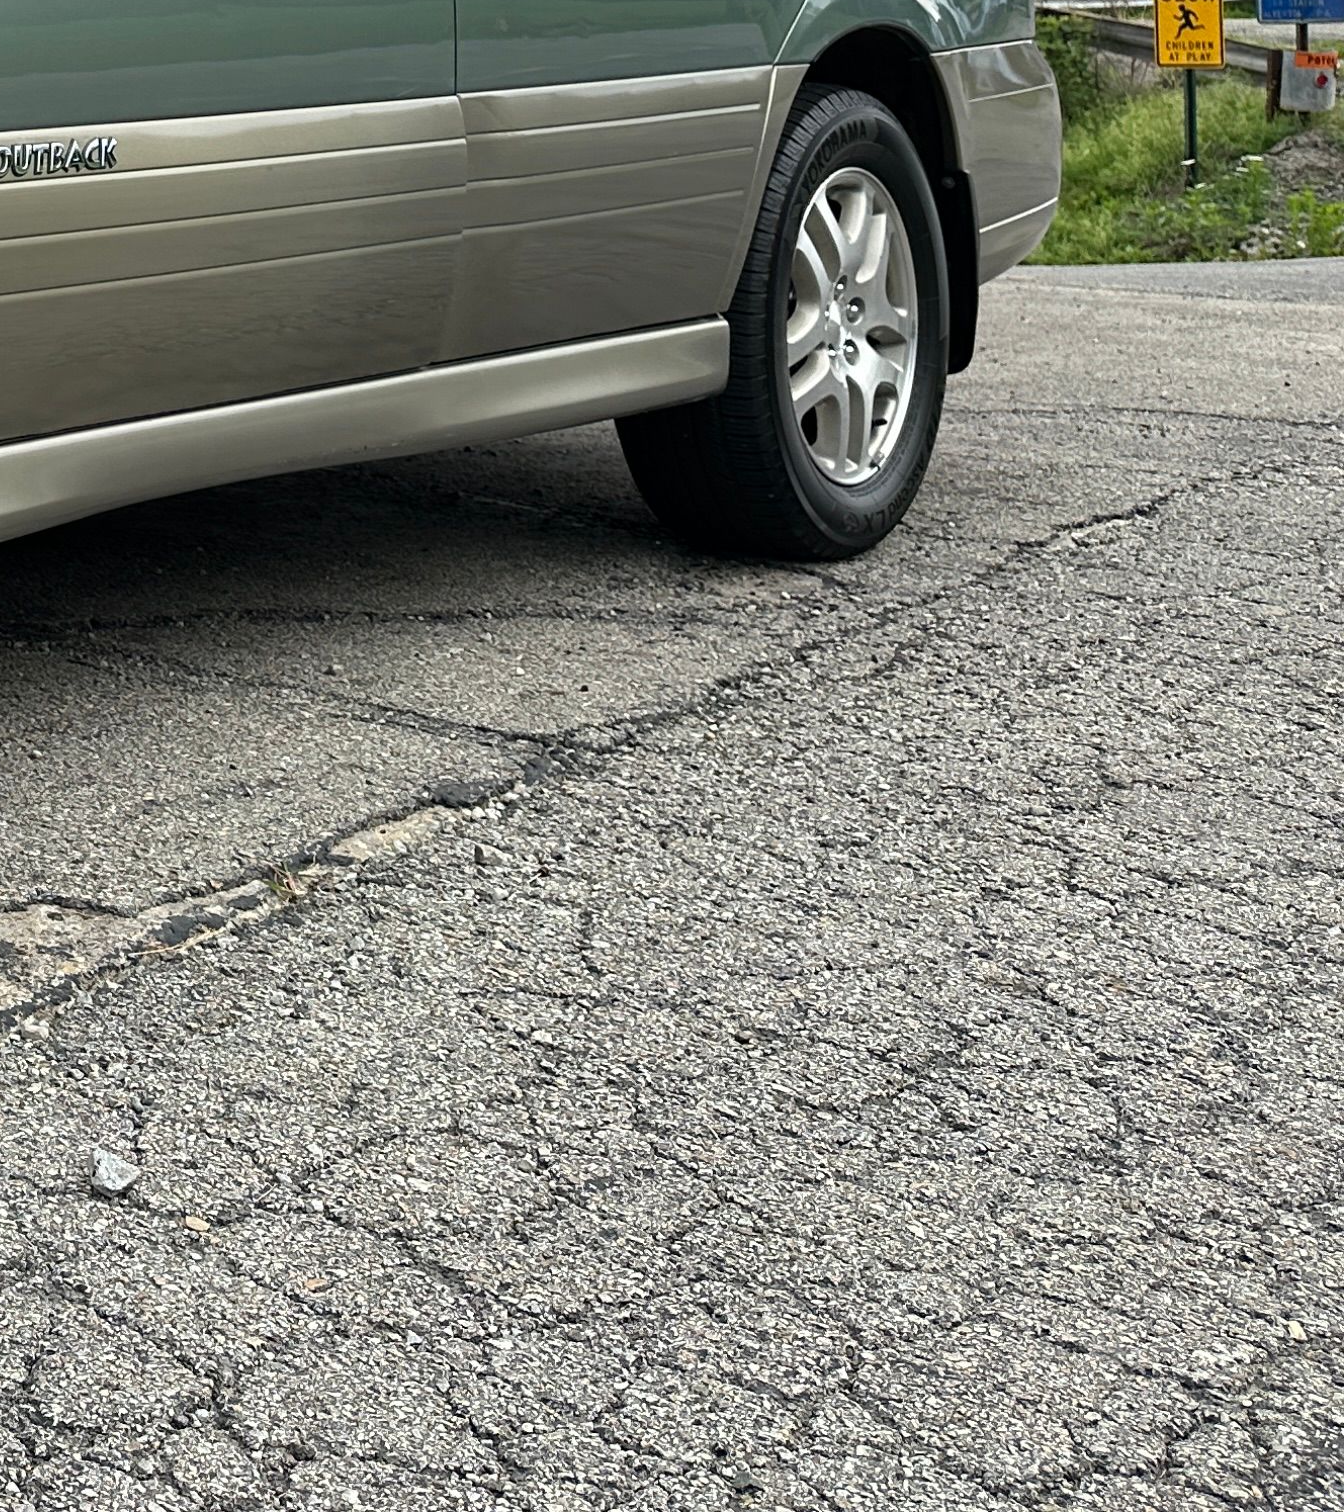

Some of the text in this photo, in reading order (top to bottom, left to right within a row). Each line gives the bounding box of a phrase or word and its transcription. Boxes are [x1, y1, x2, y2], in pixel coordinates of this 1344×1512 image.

[1166, 40, 1214, 50] CHILDREN
[1169, 52, 1211, 61] AT PLAY
